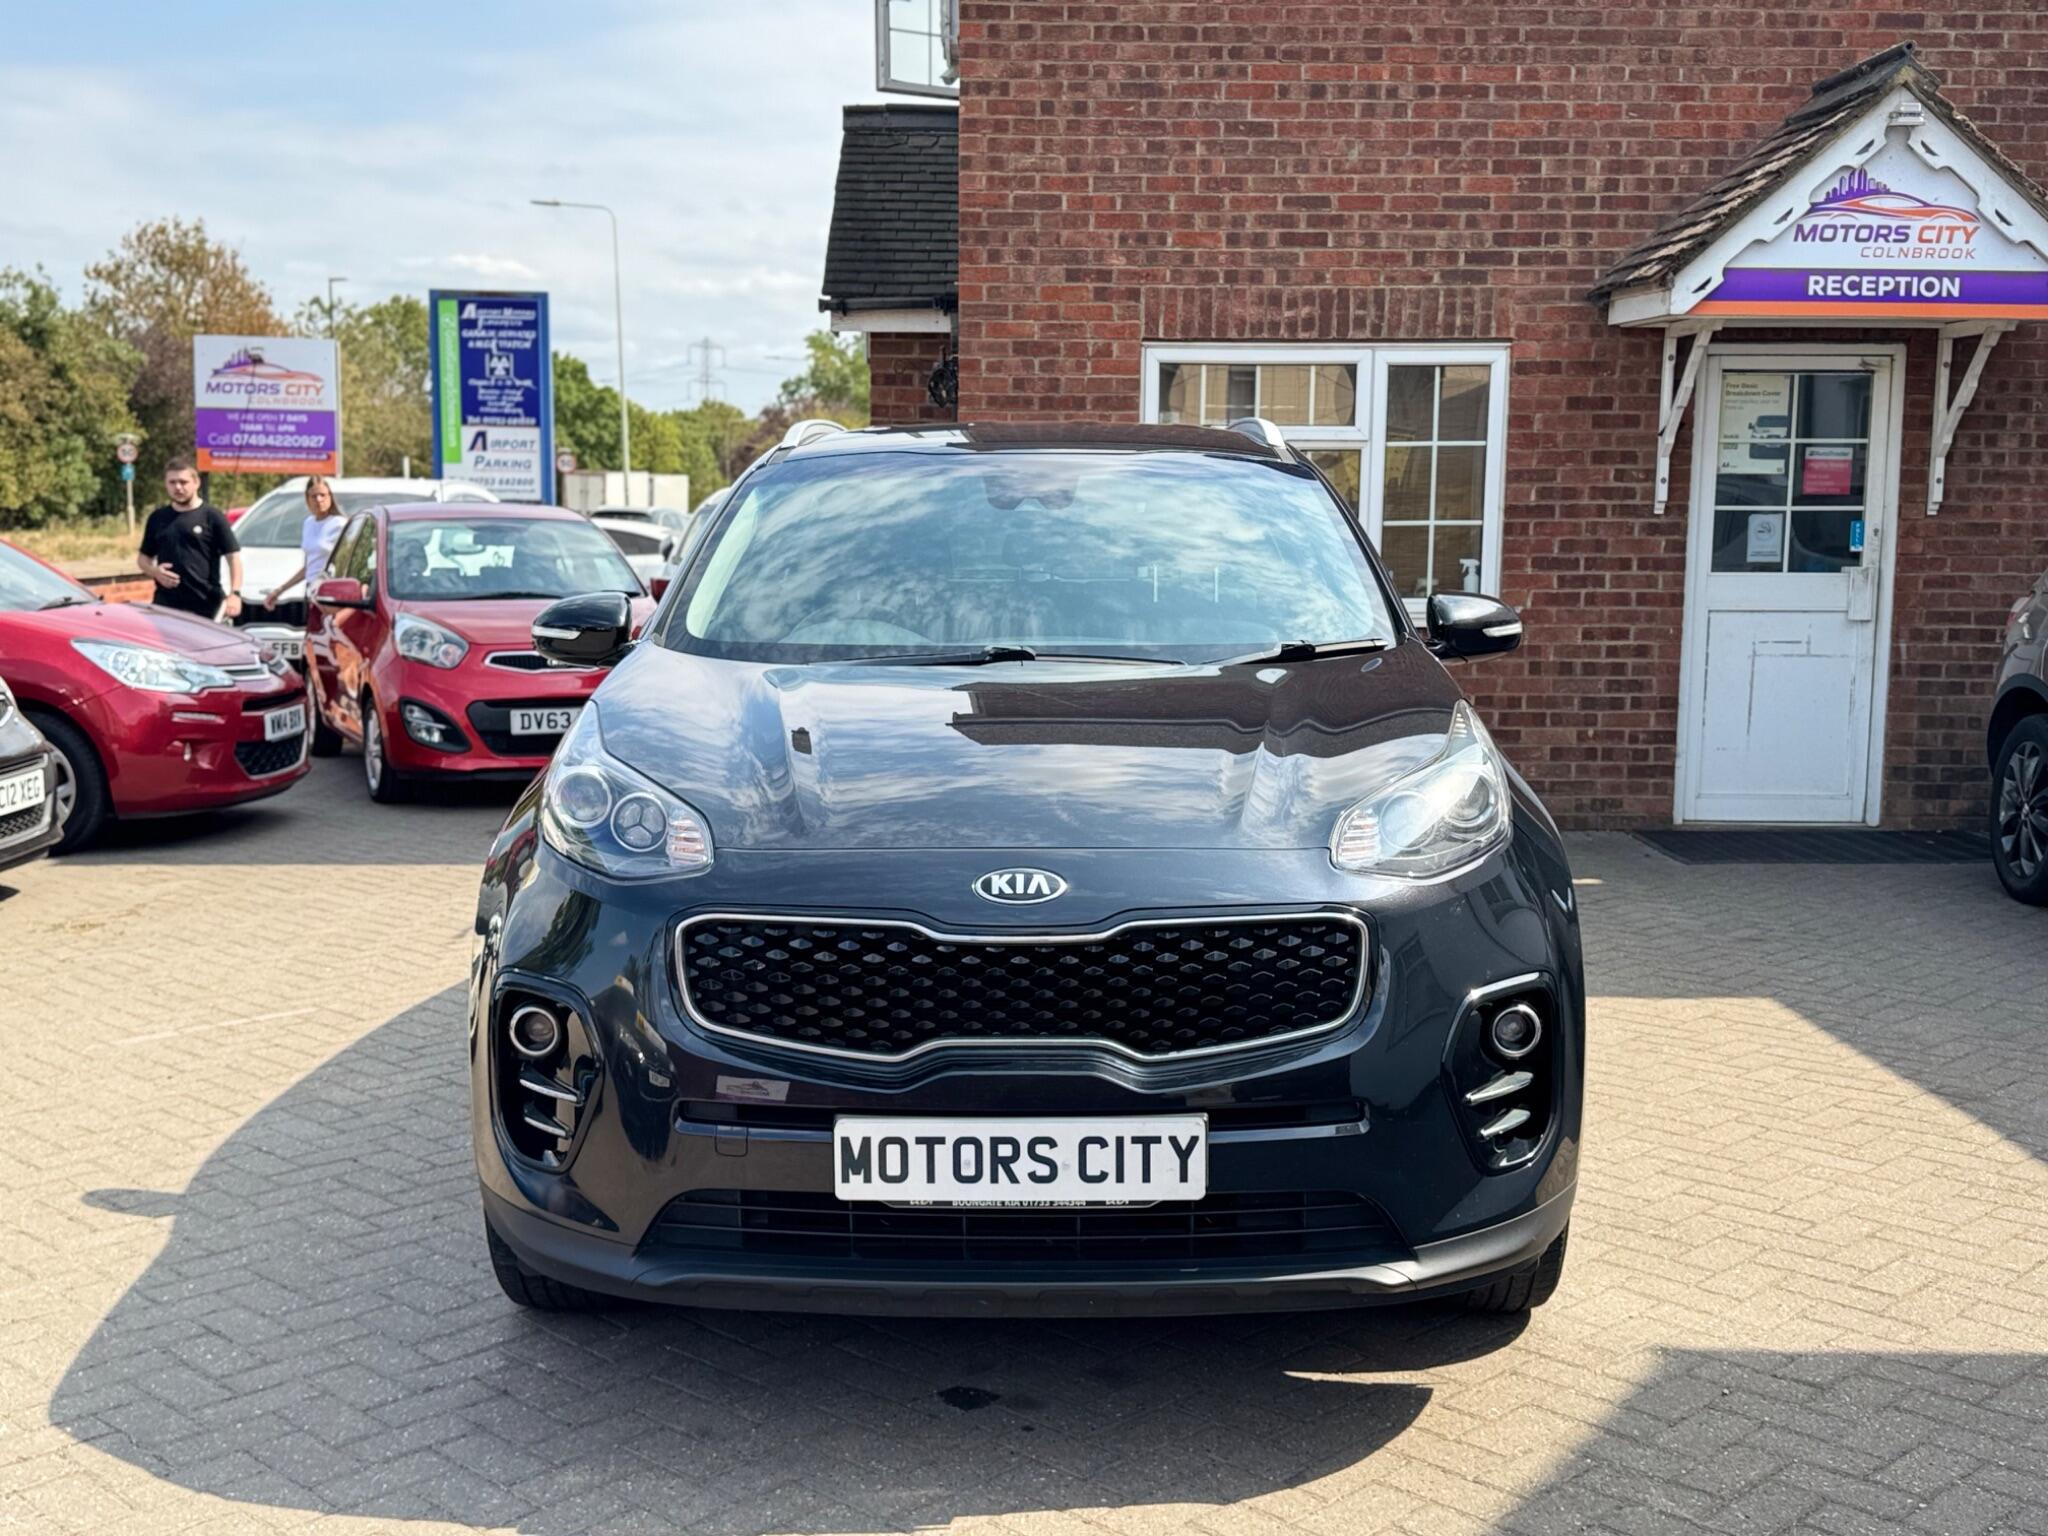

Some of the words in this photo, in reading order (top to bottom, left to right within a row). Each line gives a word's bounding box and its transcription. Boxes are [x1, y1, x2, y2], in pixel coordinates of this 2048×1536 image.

[1793, 223, 1911, 243] MOTORS
[1917, 224, 1980, 245] CITY
[1860, 246, 1976, 260] COLNBROOK
[1807, 275, 1961, 298] RECEPTION
[205, 382, 280, 395] MOTORS
[285, 383, 324, 395] CITY
[207, 433, 230, 446] Call
[467, 430, 535, 452] AIRPORT
[474, 455, 532, 469] PARKING
[520, 711, 572, 731] DV63
[19, 776, 40, 804] XEG
[991, 873, 1052, 895] KIA
[840, 1136, 1058, 1184] MOTORS
[1077, 1135, 1200, 1184] CITY
